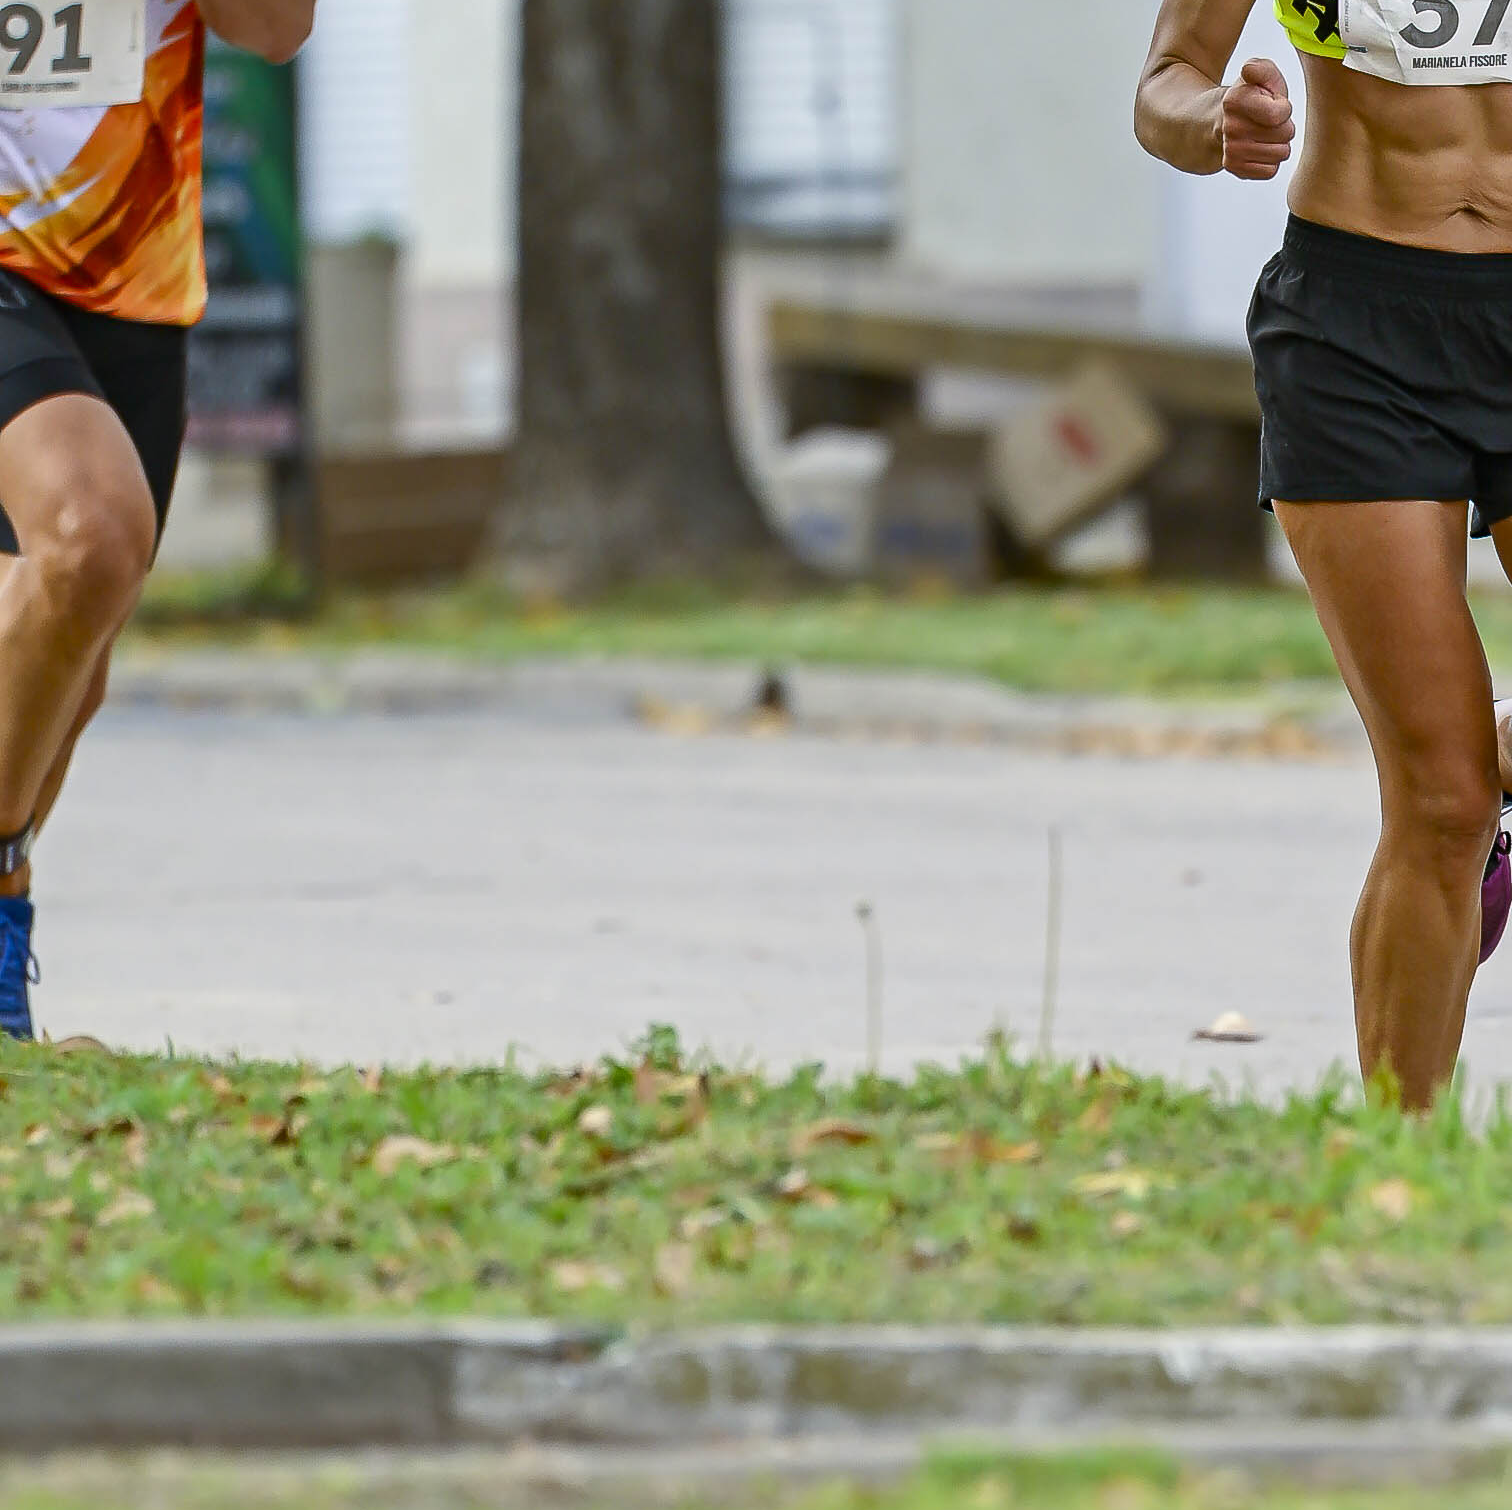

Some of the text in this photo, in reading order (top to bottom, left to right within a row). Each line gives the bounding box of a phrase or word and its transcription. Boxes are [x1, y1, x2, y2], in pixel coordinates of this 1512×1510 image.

[0, 3, 92, 75] 91
[1412, 54, 1508, 68] MARIANELA FISSORE
